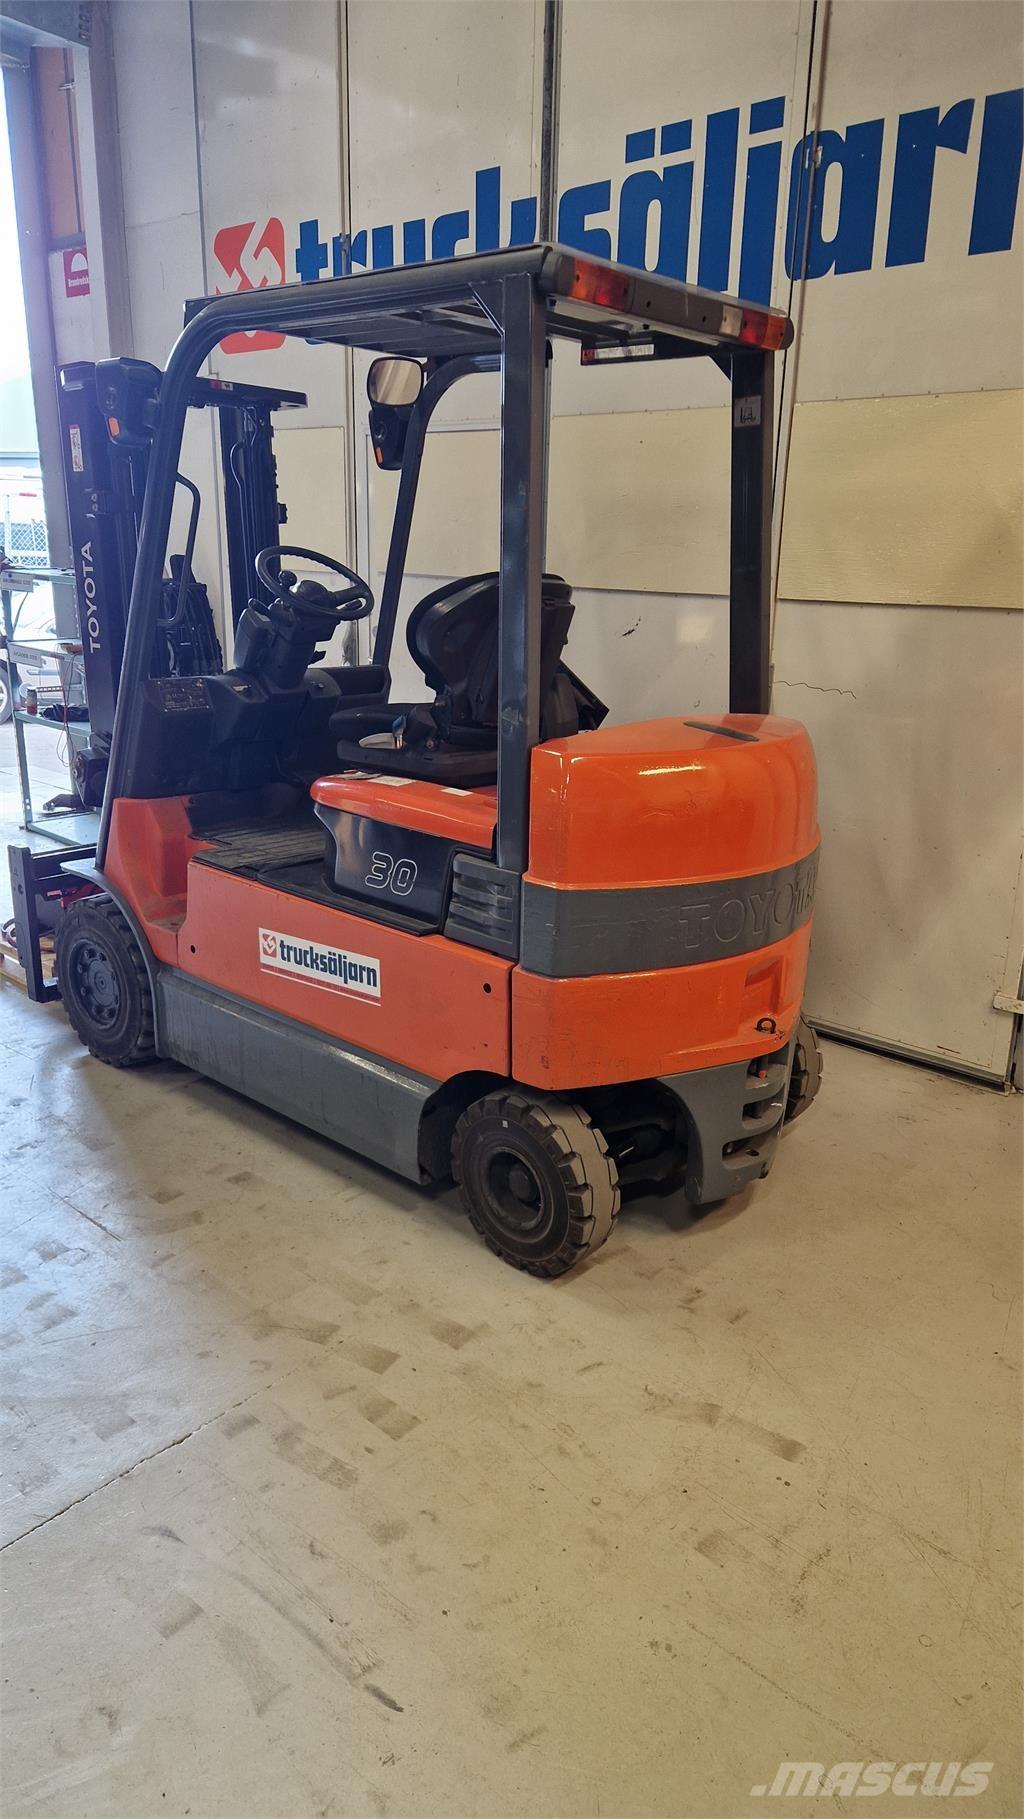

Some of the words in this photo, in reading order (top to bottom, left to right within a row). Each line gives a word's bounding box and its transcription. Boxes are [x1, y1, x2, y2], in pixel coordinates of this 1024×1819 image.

[81, 541, 101, 653] TOYOTA
[365, 851, 417, 896] 30
[280, 940, 377, 987] trucksäljarn
